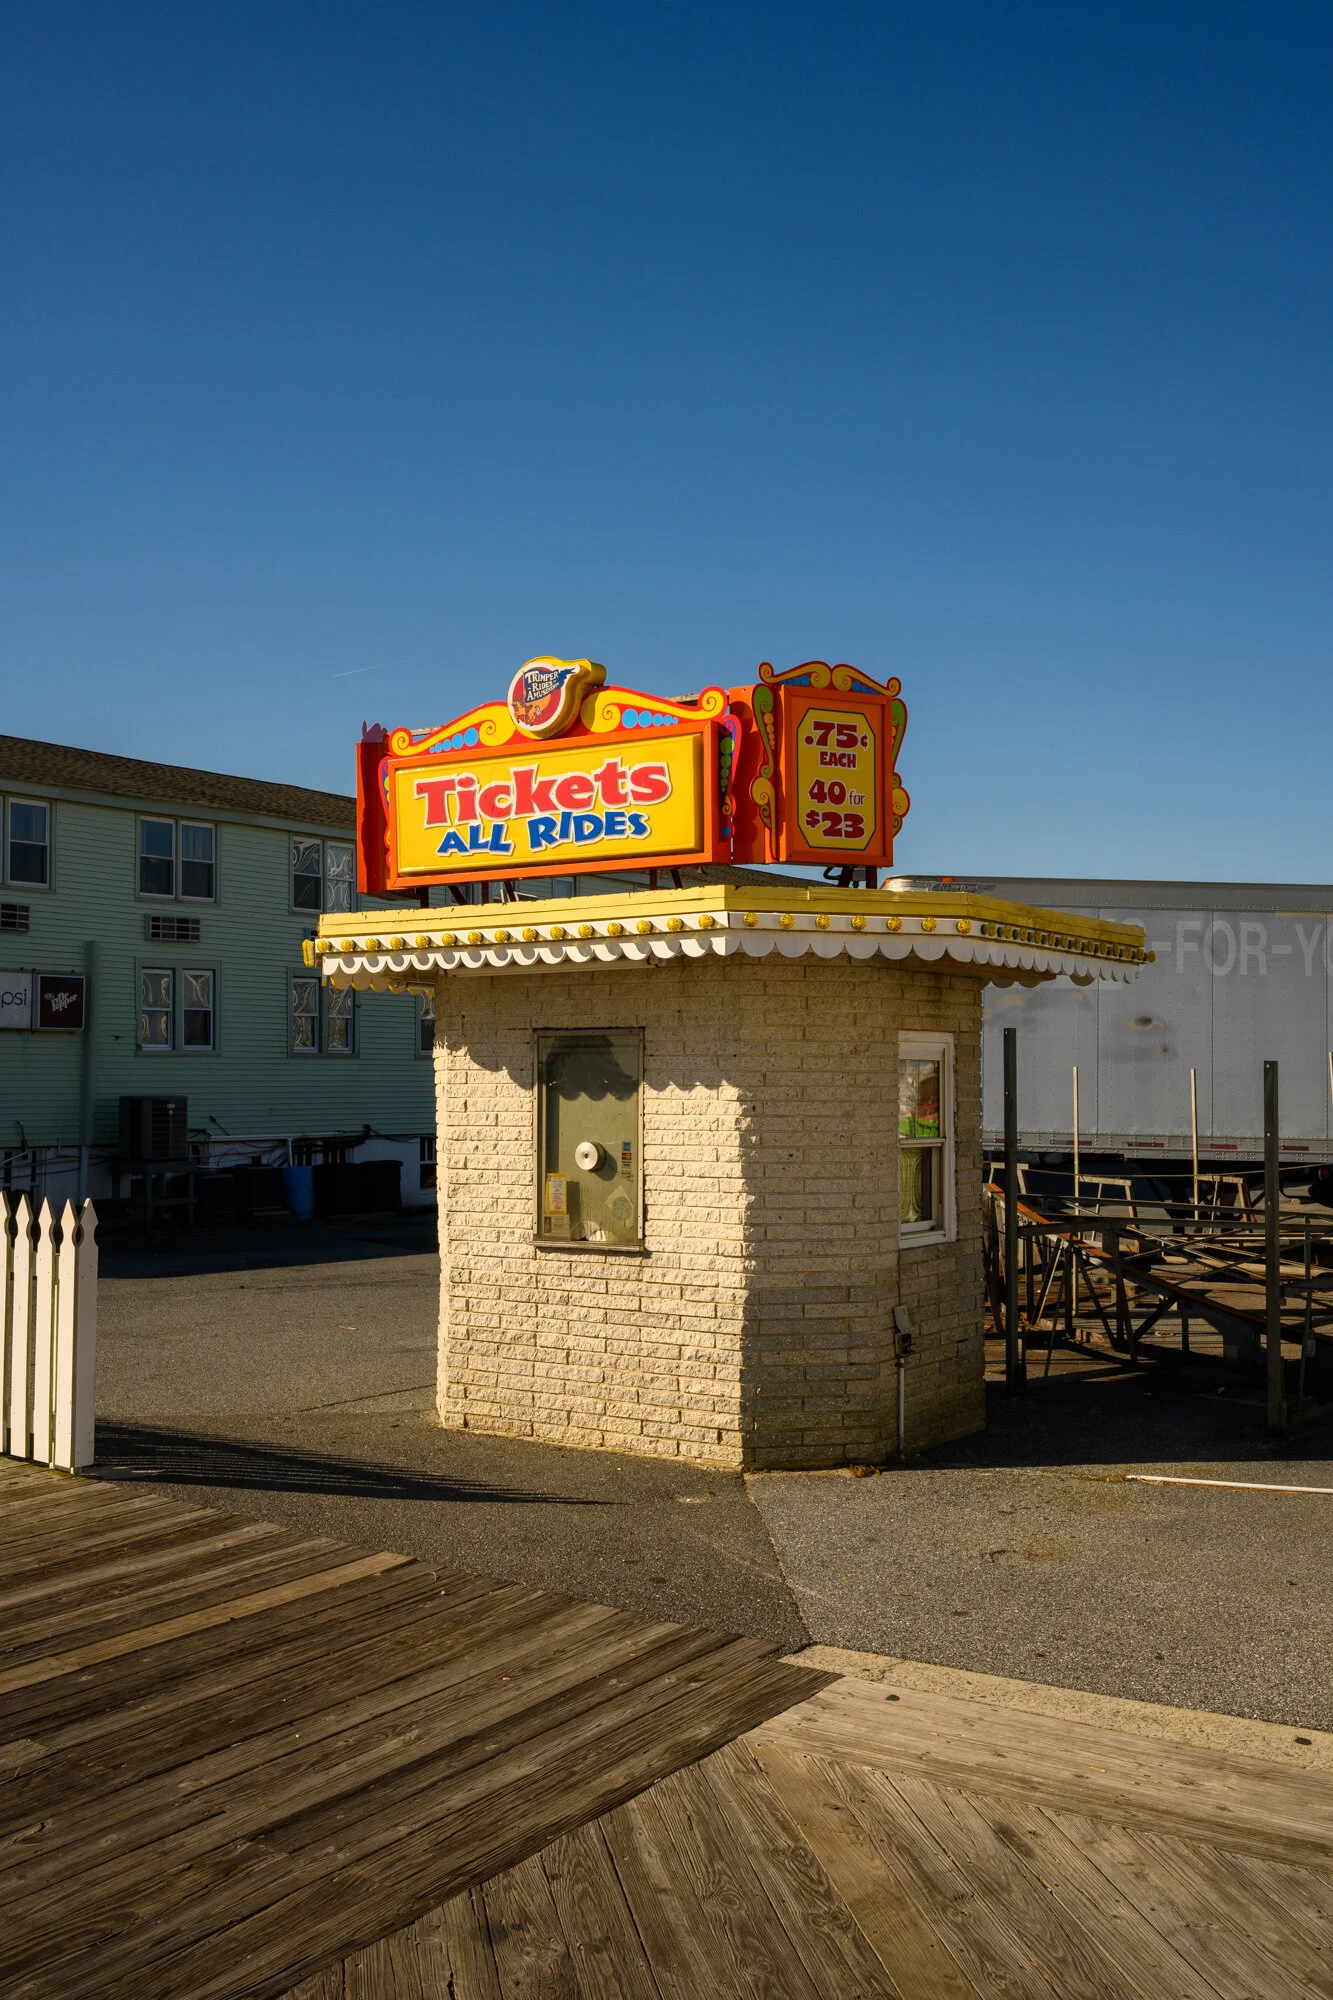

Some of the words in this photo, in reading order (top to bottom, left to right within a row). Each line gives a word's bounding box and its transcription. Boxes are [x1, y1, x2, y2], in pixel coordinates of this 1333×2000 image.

[525, 671, 559, 684] TRIMPER
[804, 720, 868, 750] .75¢
[819, 751, 857, 769] EACH
[414, 756, 671, 829] Tickets
[808, 779, 847, 805] 40
[849, 790, 865, 806] for
[436, 821, 514, 856] ALL
[528, 810, 650, 853] RIDES
[805, 809, 865, 839] $23
[51, 994, 77, 1012] Pepper
[58, 992, 69, 1001] Dr
